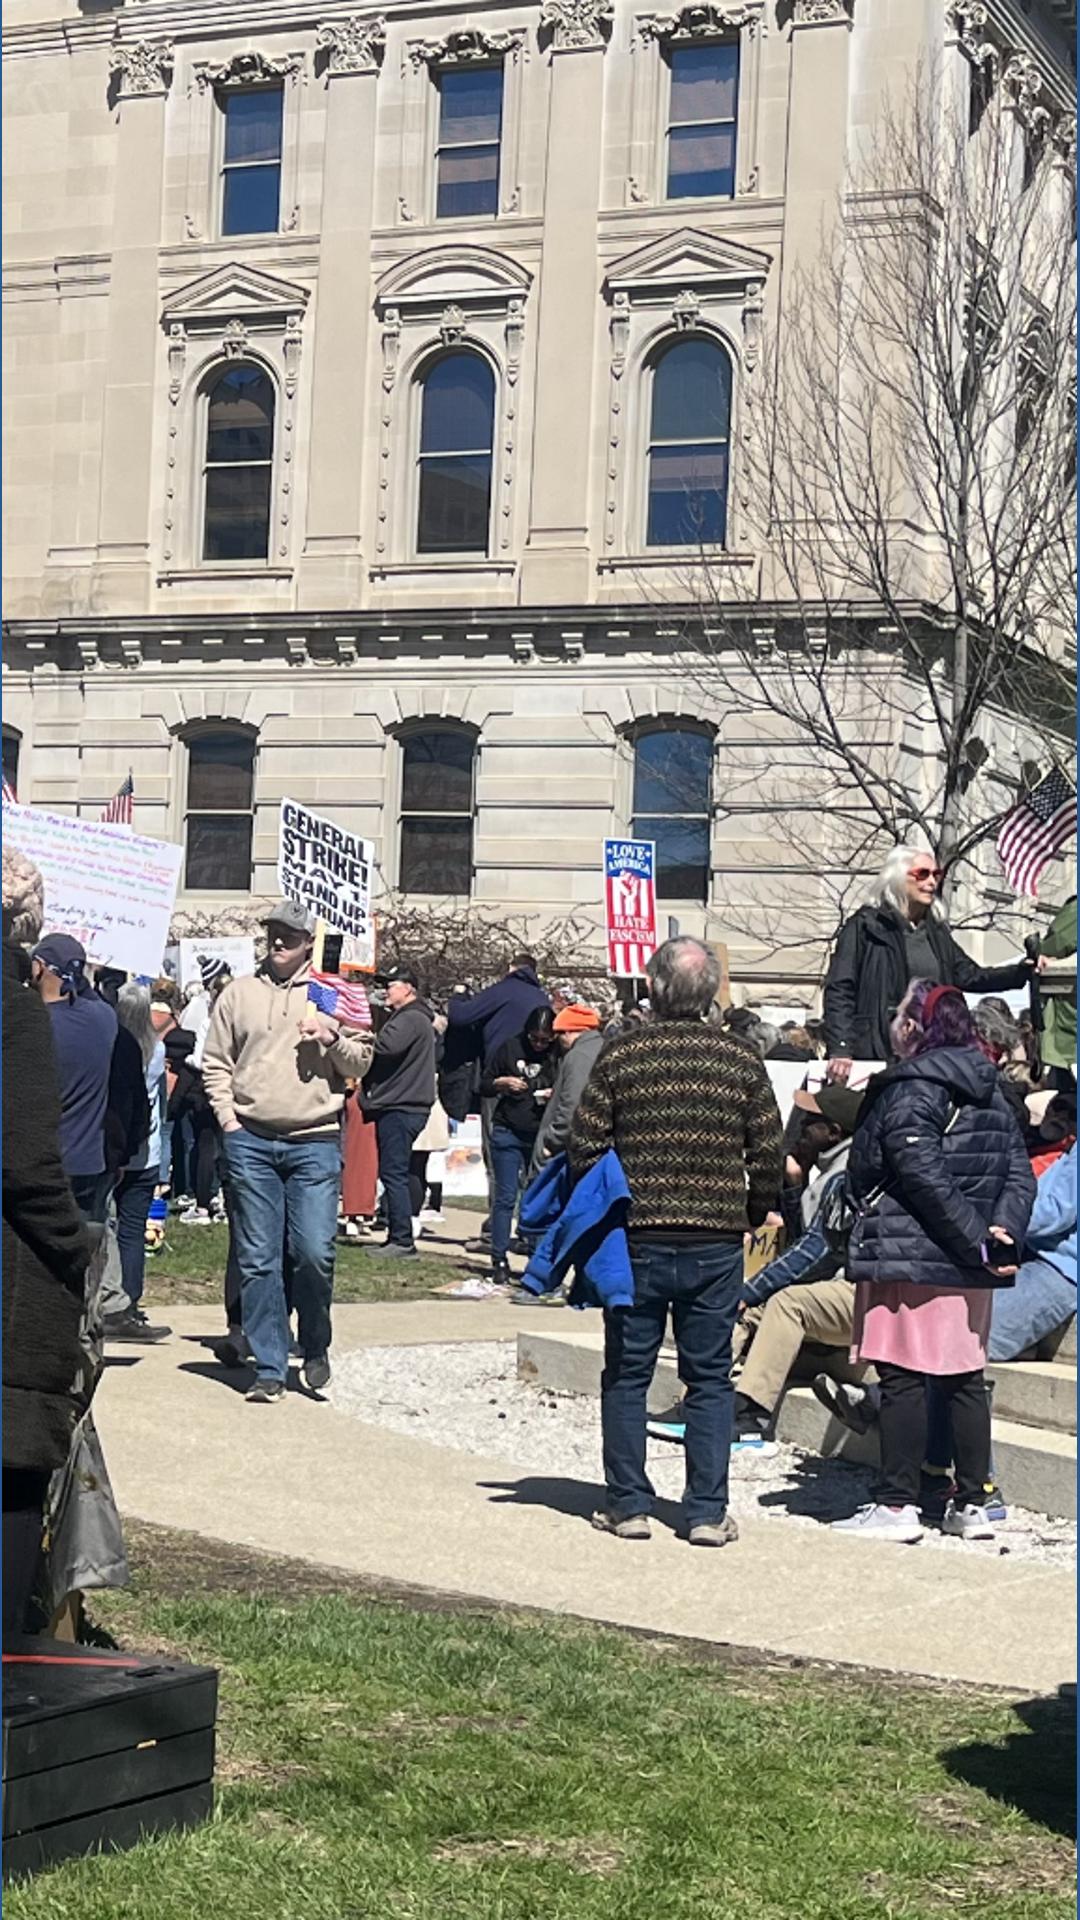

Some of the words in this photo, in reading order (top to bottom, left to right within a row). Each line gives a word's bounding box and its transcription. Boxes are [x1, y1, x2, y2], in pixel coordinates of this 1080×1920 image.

[283, 804, 368, 864] GENERAL
[283, 828, 367, 890] STRIKE!
[608, 858, 651, 874] AMERICA
[612, 844, 646, 860] LOVE
[284, 854, 345, 889] MAY
[282, 867, 338, 910] STAND
[342, 904, 366, 920] UP
[307, 900, 366, 937] TRUMP
[610, 929, 655, 943] FASCISM
[615, 915, 648, 929] HATE
